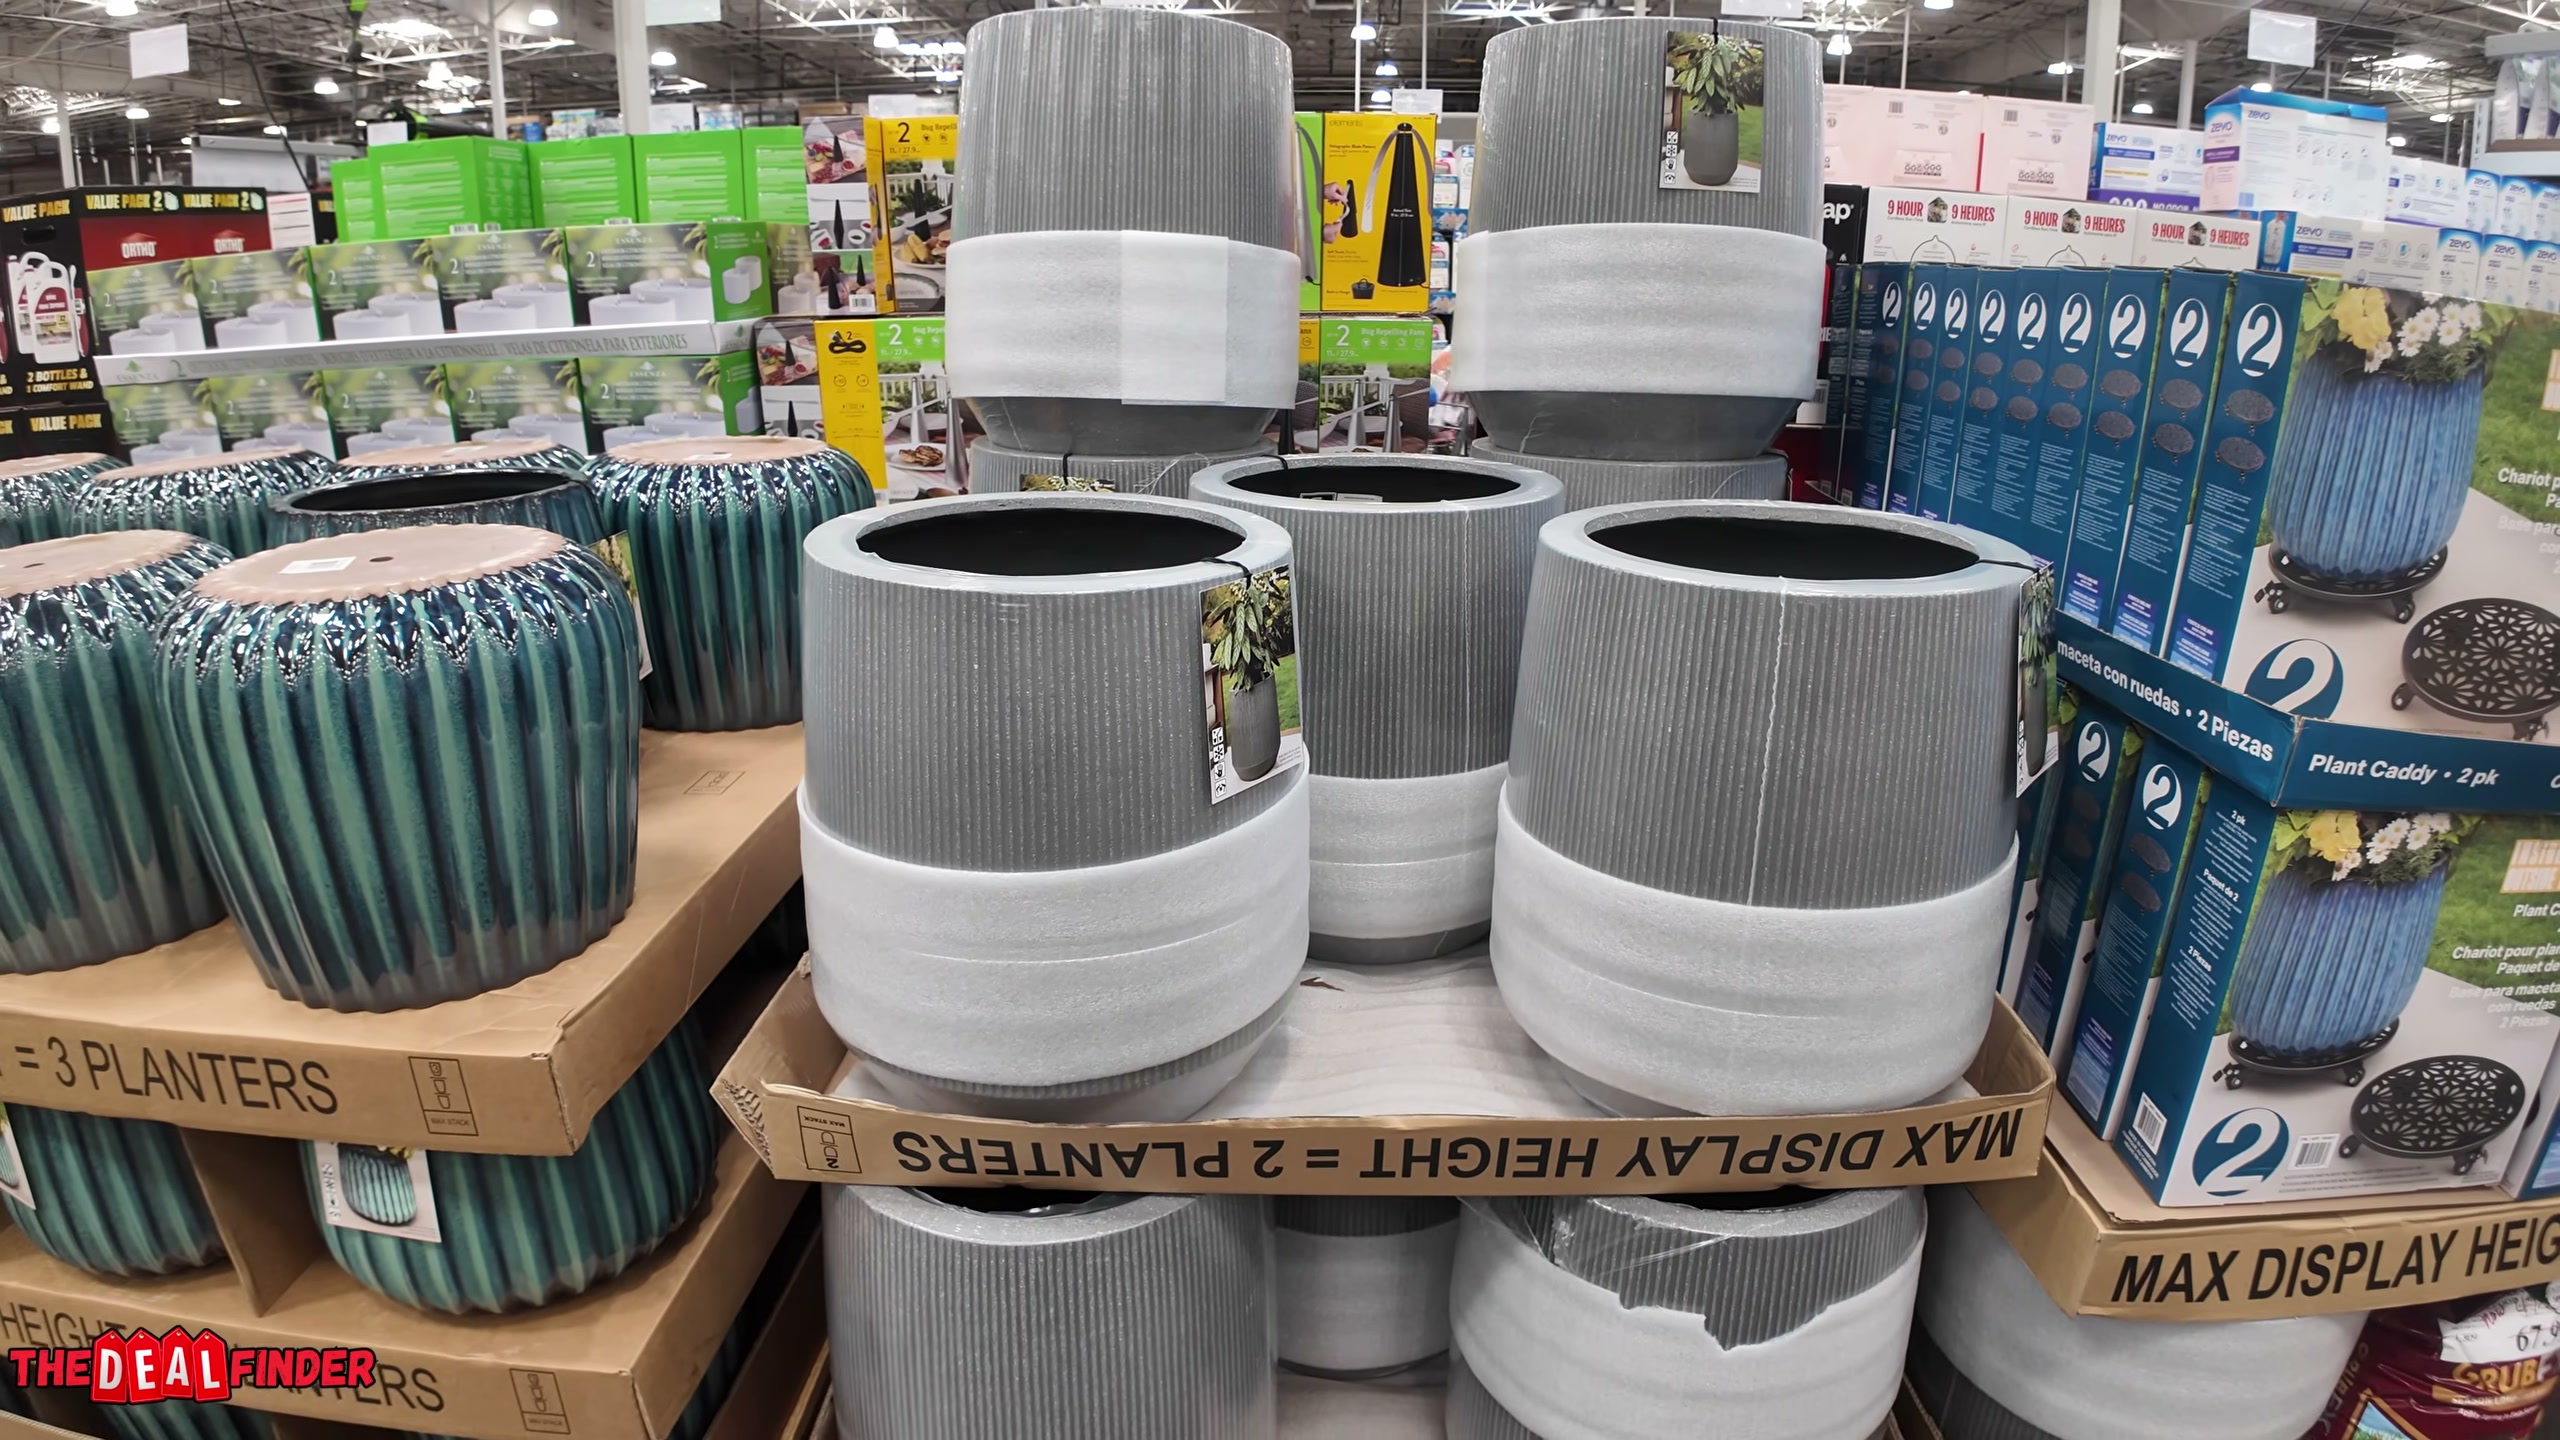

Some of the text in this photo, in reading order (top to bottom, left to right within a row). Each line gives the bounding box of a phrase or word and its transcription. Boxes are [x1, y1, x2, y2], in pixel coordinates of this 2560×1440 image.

[2248, 110, 2271, 121] zevo
[898, 122, 911, 143] 2
[2211, 121, 2233, 133] zevo
[86, 191, 163, 210] VALUE PACK 2
[182, 190, 250, 208] VALUE PACK 2
[3, 200, 70, 222] VALUE PACK
[1887, 199, 1996, 222] 9 HOUR 9 HEURES
[2024, 210, 2126, 233] 9 HOUR 9 HEURES
[2152, 222, 2250, 246] 9 HOUR 9 HEURES
[2296, 226, 2323, 237] zevo
[121, 241, 156, 259] ORTHO
[213, 237, 245, 254] ORTHO
[2449, 239, 2472, 249] zevo
[2494, 244, 2516, 255] zevo
[450, 258, 459, 275] 2
[586, 251, 596, 268] 2
[328, 270, 337, 285] 2
[1884, 282, 1902, 327] 2
[1913, 282, 1936, 330] 2
[1945, 288, 1968, 338] 2
[1979, 290, 2006, 342] 2
[2017, 293, 2047, 348] 2
[2060, 293, 2092, 352] 2
[888, 323, 903, 345] 2
[1336, 324, 1350, 346] 2
[2109, 295, 2146, 358] 2
[2170, 299, 2209, 366] 2
[628, 333, 689, 351] EXTERIORES
[2238, 304, 2283, 376] 2
[27, 368, 88, 383] 2 BOTTLES &
[33, 383, 67, 393] COMFORT
[68, 381, 94, 391] WAND
[467, 388, 475, 403] 2
[601, 384, 609, 399] 2
[342, 394, 350, 409] 2
[30, 413, 103, 432] VALUE PACK
[2498, 467, 2551, 487] Chariot
[2262, 638, 2337, 715] 2
[2057, 639, 2273, 763] maceta con ruedas 2 Piezas
[2078, 722, 2110, 782] 2
[2309, 753, 2499, 789] Plant Caddy 2 pk
[2143, 764, 2181, 829] 2
[2513, 903, 2548, 918] Plant
[2453, 945, 2503, 960] Chariot
[2504, 947, 2535, 961] pour
[2497, 961, 2543, 976] Paquet
[2483, 986, 2514, 999] para
[2487, 999, 2557, 1014] con ruedas
[2509, 1015, 2550, 1028] Piezas
[47, 1036, 76, 1088] 3
[81, 1039, 339, 1115] PLANTERS
[804, 1115, 846, 1128] MAX STACK
[892, 1108, 2024, 1179] MAX DISPLAY HEIGHT = 2 PLANTERS
[2195, 1108, 2285, 1194] 2
[2111, 1250, 2241, 1303] MAX
[2248, 1228, 2459, 1300] DISPLAY
